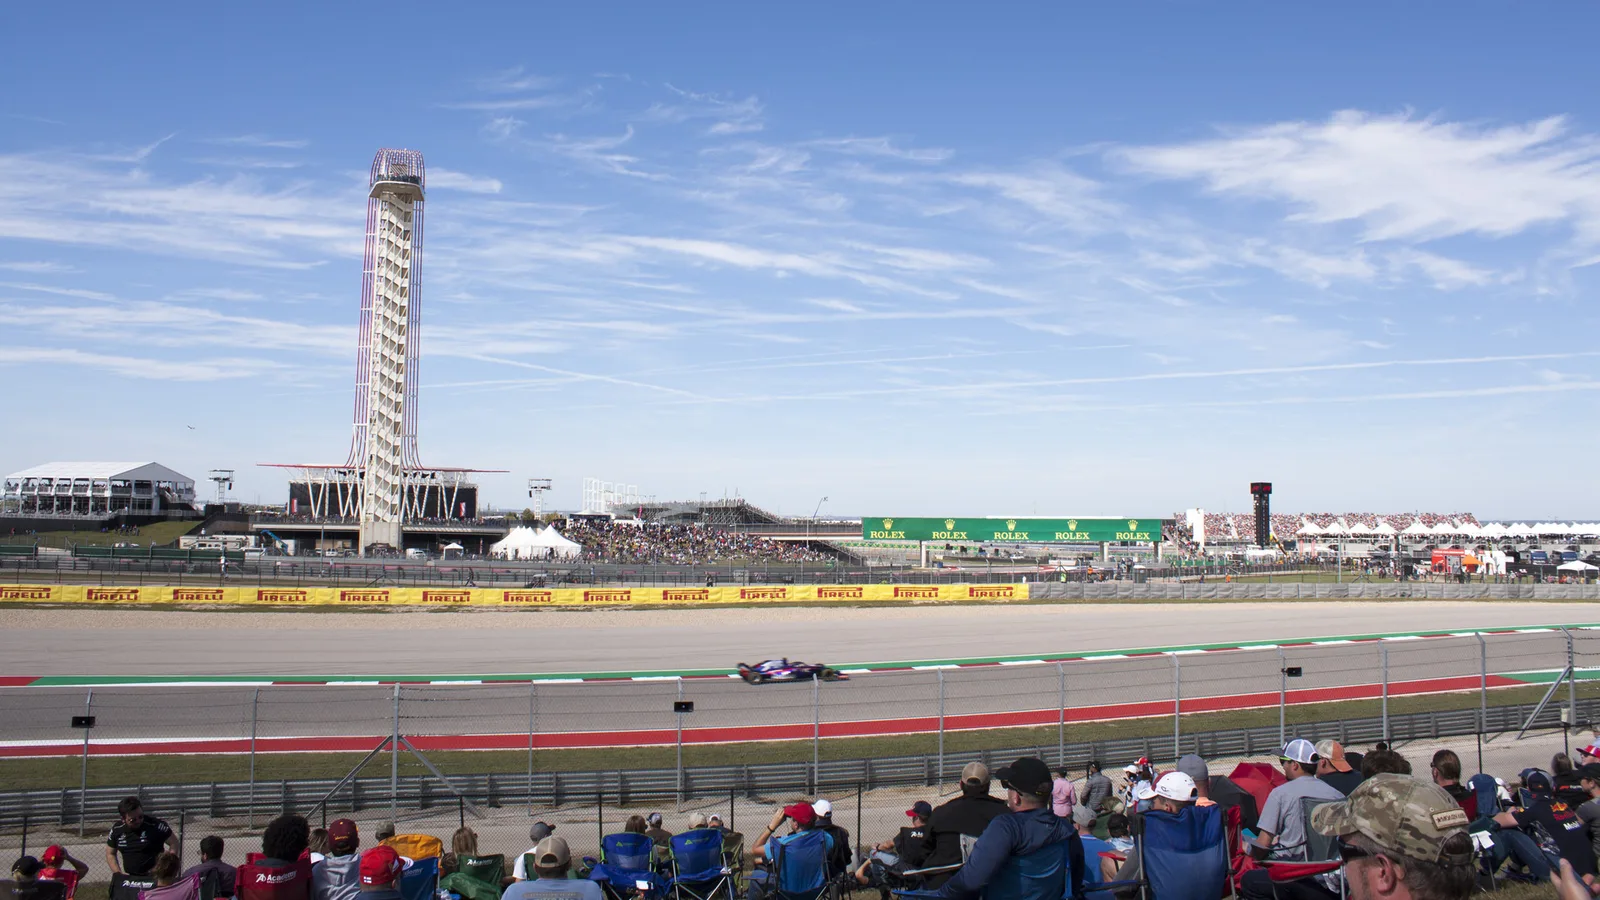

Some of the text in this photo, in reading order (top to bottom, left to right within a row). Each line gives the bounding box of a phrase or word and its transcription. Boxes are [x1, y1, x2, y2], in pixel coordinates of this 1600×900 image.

[870, 531, 905, 539] ROLEX
[932, 531, 967, 539] ROLEX
[994, 532, 1029, 540] ROLEX
[1055, 532, 1090, 540] ROLEX
[1115, 532, 1150, 540] ROLEX
[87, 588, 139, 600] PIRELLI
[173, 588, 224, 601] PIRELLI
[257, 589, 307, 602] PIRELLI
[340, 590, 390, 602] PIRELLI
[422, 591, 471, 602] PIRELLI
[504, 591, 552, 602] PIRELLI
[583, 590, 631, 602] PIRELLI
[663, 590, 709, 601] PIRELLI
[740, 588, 787, 599] PIRELLI
[817, 587, 863, 598] PIRELLI
[894, 587, 939, 598] PIRELLI
[969, 587, 1014, 598] PIRELLI
